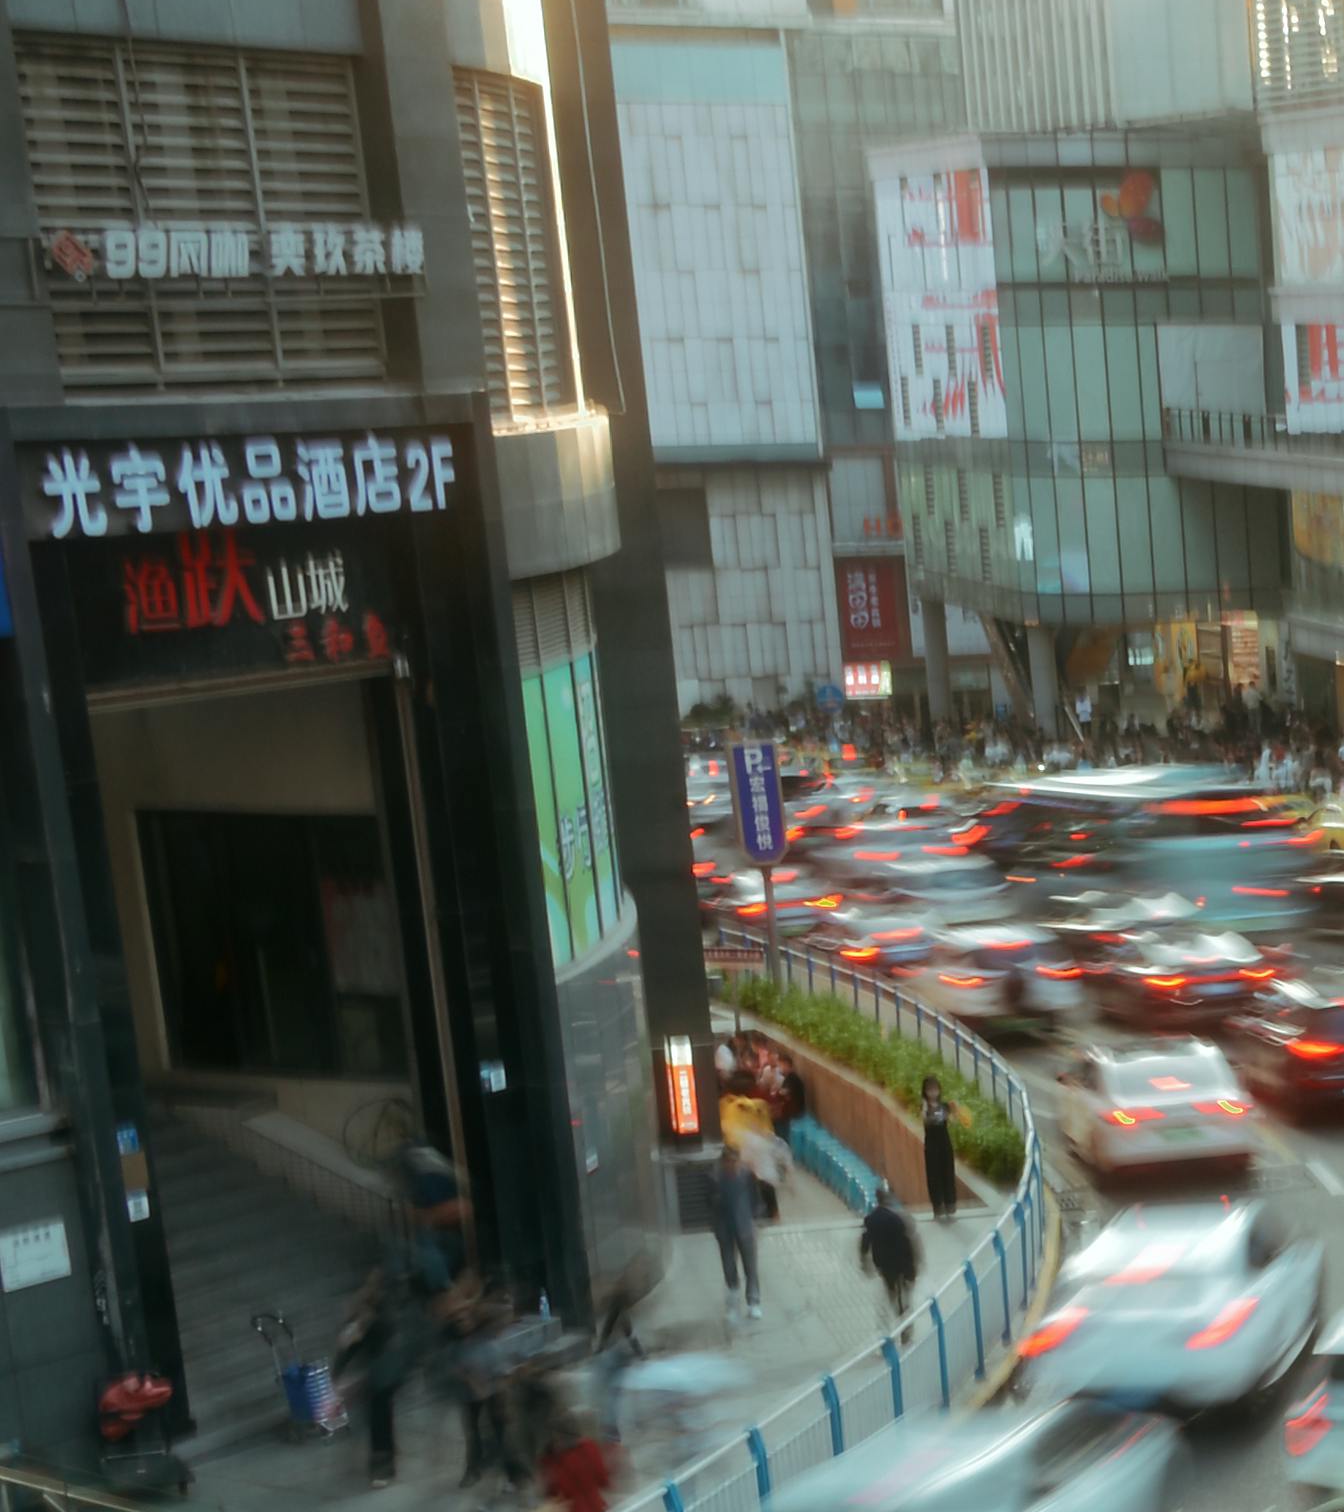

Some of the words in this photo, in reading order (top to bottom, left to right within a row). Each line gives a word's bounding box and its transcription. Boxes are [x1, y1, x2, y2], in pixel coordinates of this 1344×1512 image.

[42, 430, 456, 539] 光宇优品酒店2F
[744, 748, 763, 775] P
